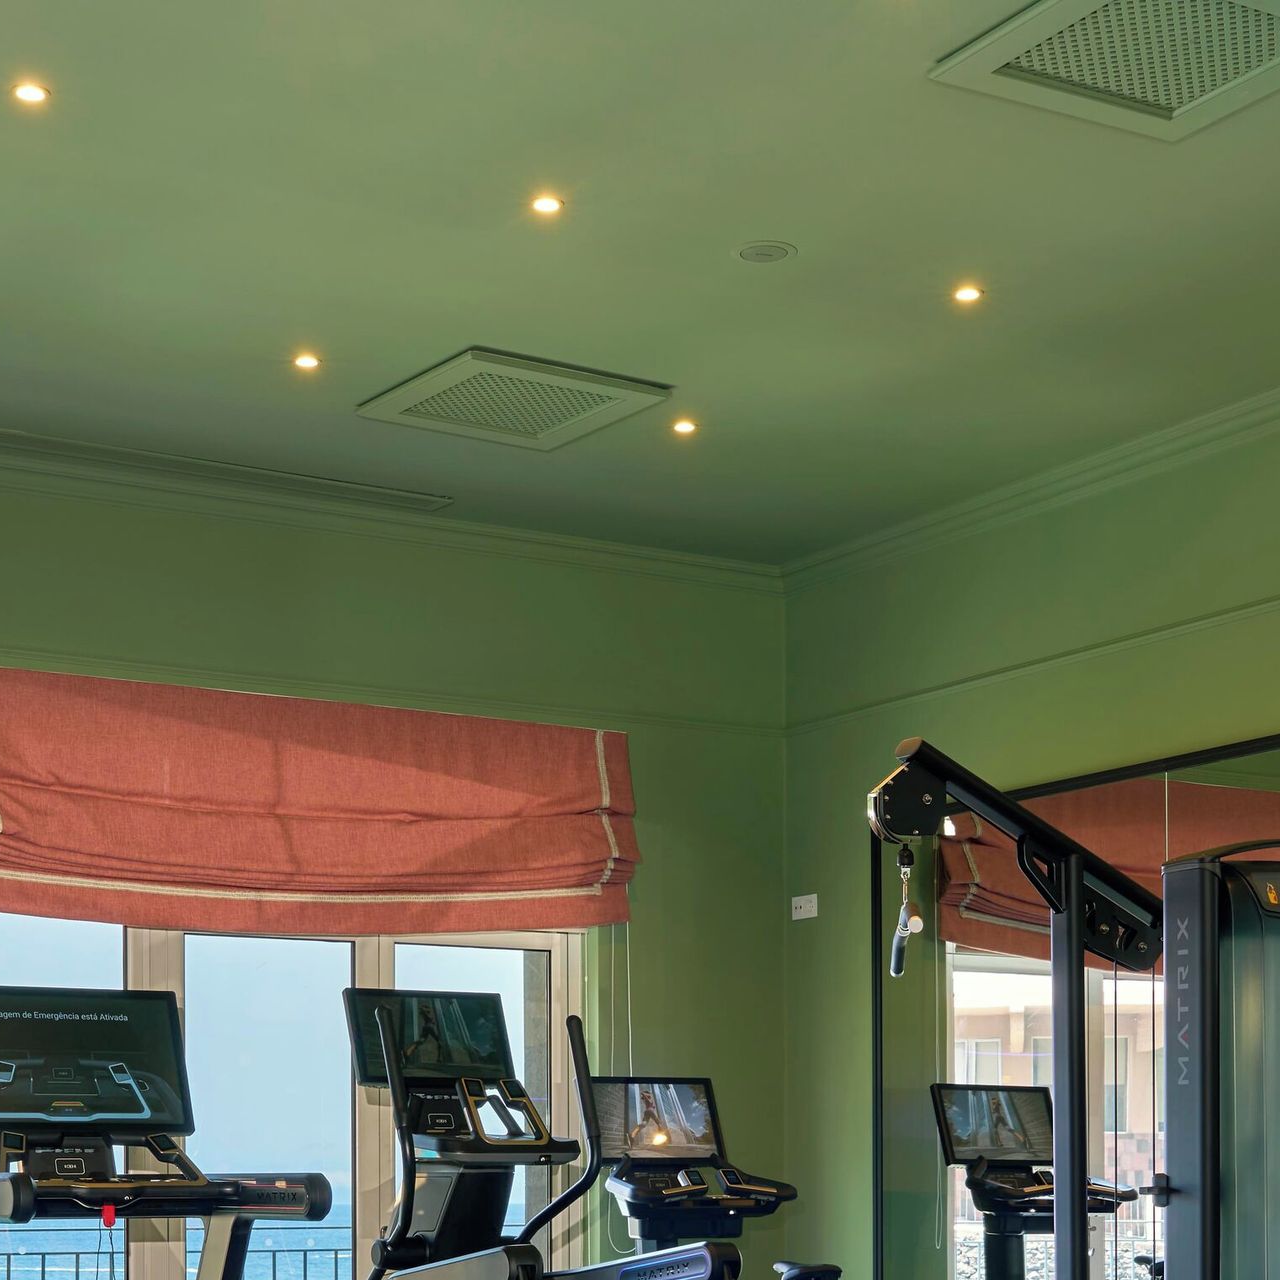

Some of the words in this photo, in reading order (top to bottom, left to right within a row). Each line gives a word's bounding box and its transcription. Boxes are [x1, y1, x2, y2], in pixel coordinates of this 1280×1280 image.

[1177, 917, 1189, 1085] MATRIX
[22, 1011, 32, 1019] de
[33, 1011, 80, 1021] Emergência
[81, 1013, 98, 1021] está
[99, 1013, 129, 1022] Ativada
[256, 1191, 297, 1202] MATRIX
